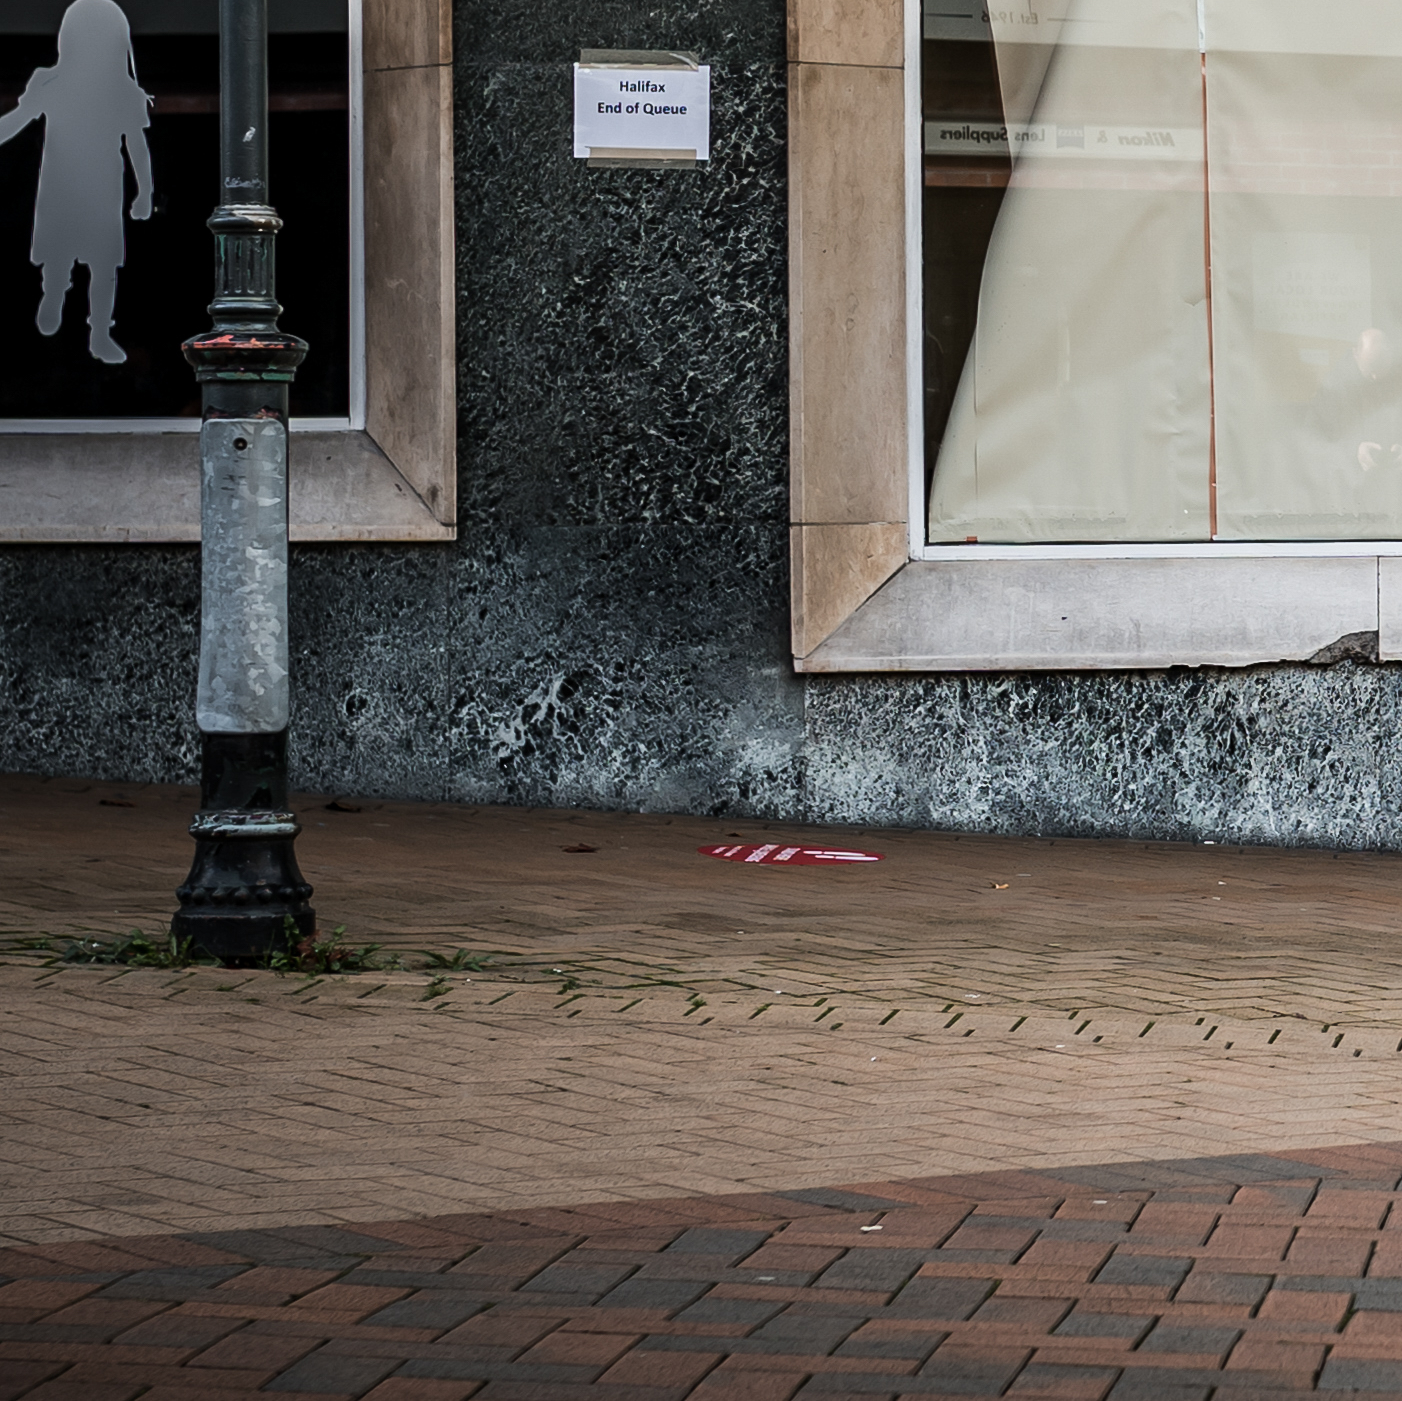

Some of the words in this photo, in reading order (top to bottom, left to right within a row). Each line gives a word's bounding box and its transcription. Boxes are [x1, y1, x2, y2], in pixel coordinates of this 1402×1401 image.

[619, 80, 666, 93] Halifax
[597, 102, 622, 114] End
[625, 102, 640, 114] of
[643, 103, 688, 116] Queue
